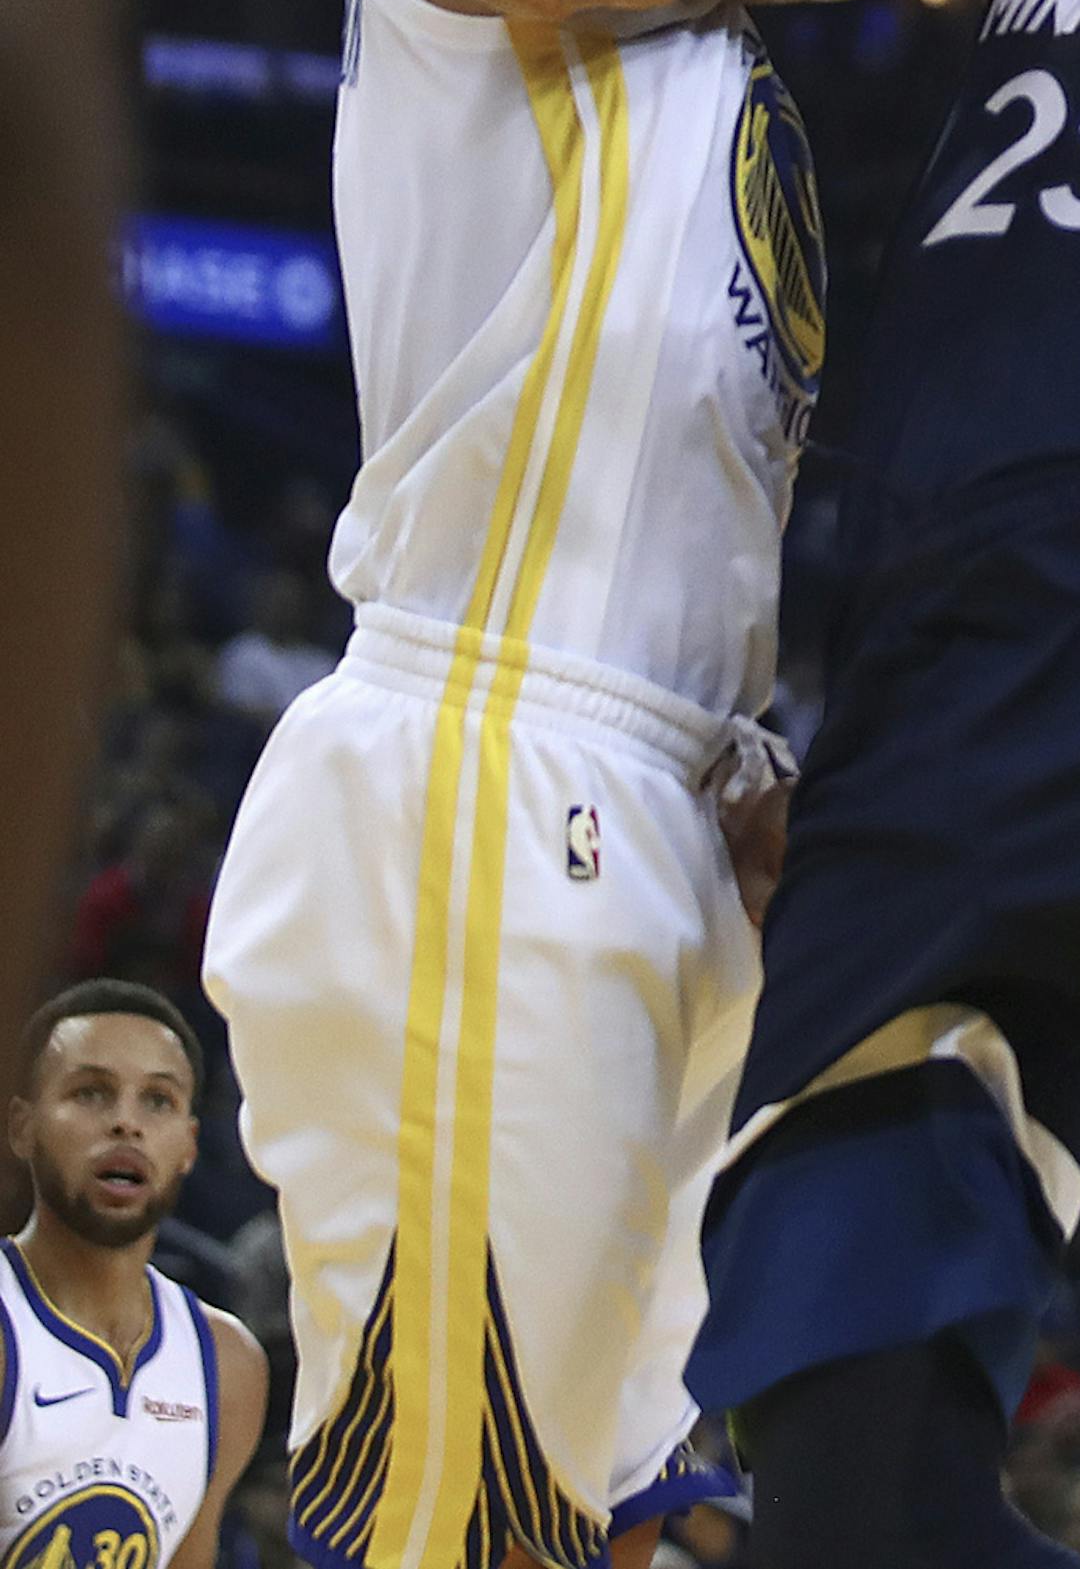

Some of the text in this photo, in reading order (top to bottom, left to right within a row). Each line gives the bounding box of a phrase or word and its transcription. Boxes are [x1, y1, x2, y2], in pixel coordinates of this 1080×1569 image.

[16, 1457, 178, 1531] GOLDEN STATE
[94, 1528, 149, 1569] 30
